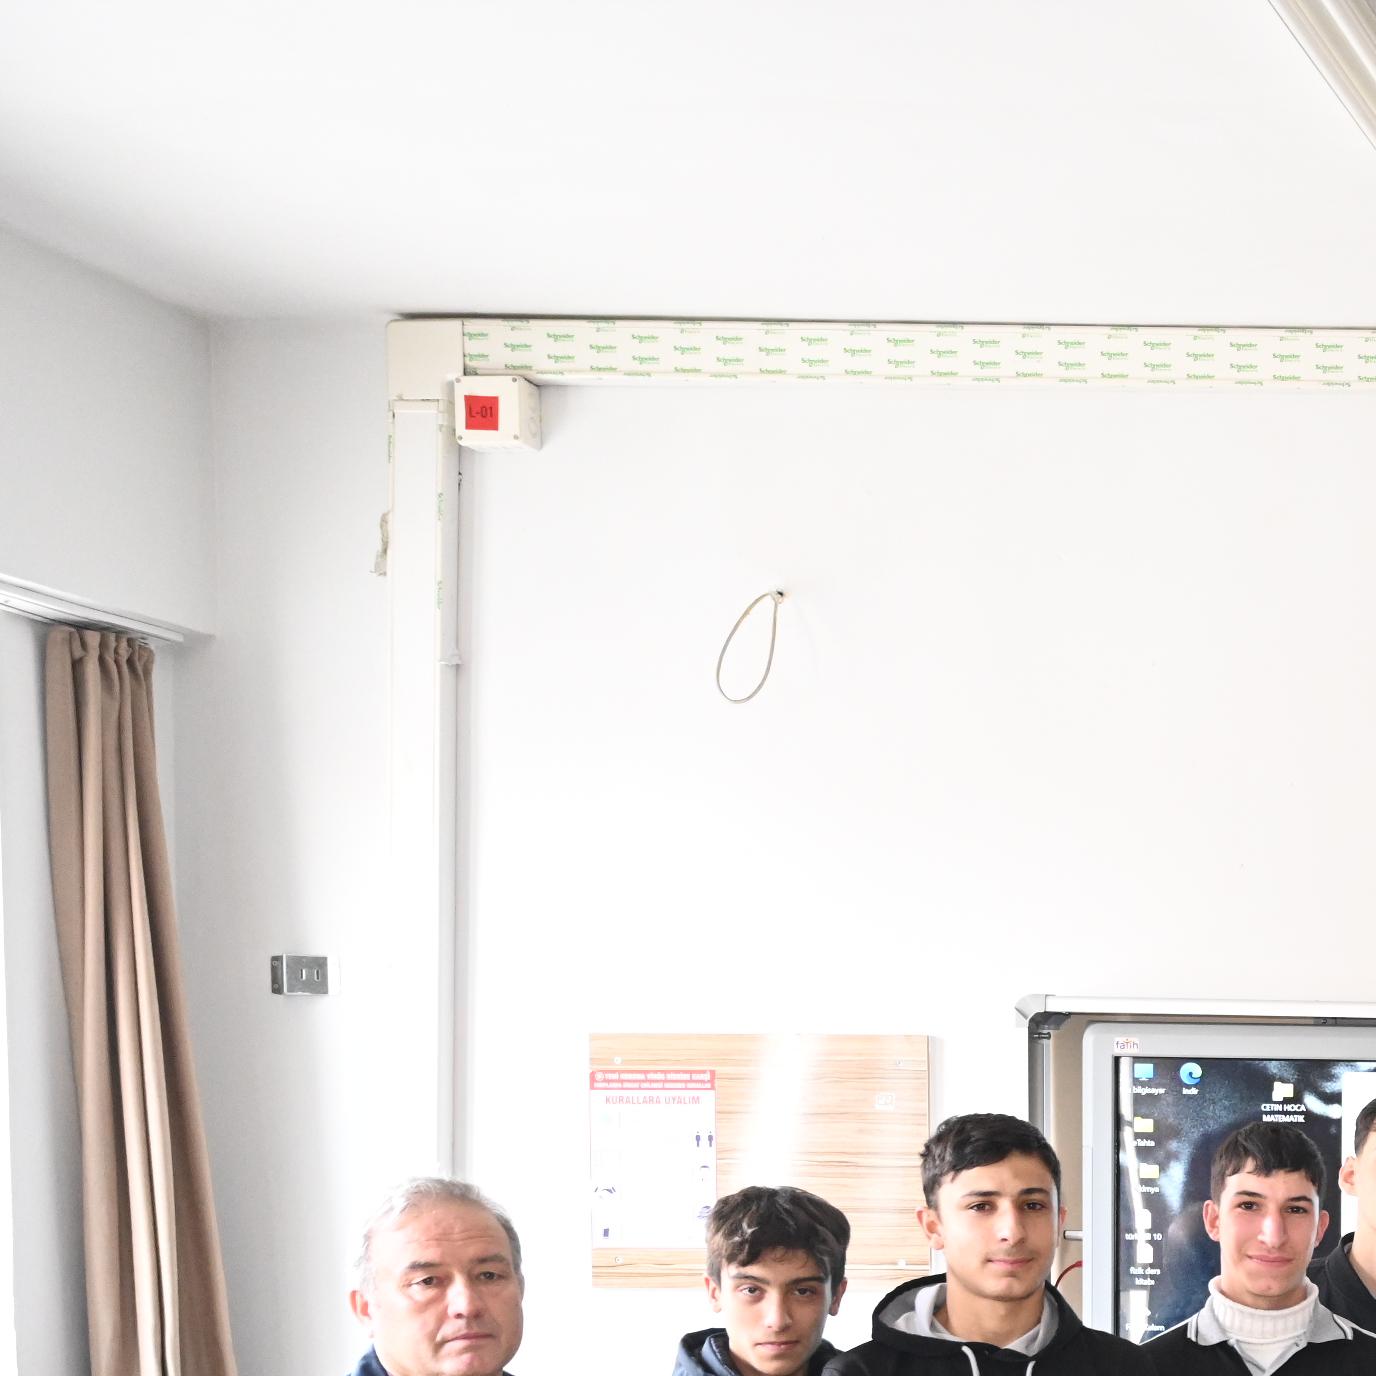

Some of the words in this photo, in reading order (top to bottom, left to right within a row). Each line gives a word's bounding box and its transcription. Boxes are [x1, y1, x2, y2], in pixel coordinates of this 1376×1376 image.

[468, 404, 493, 418] L-01
[1115, 1039, 1139, 1050] fatih
[605, 1096, 661, 1105] KURALLARA
[664, 1096, 701, 1105] UYALIM
[1283, 1103, 1306, 1112] HOCA
[1152, 1233, 1163, 1241] 10
